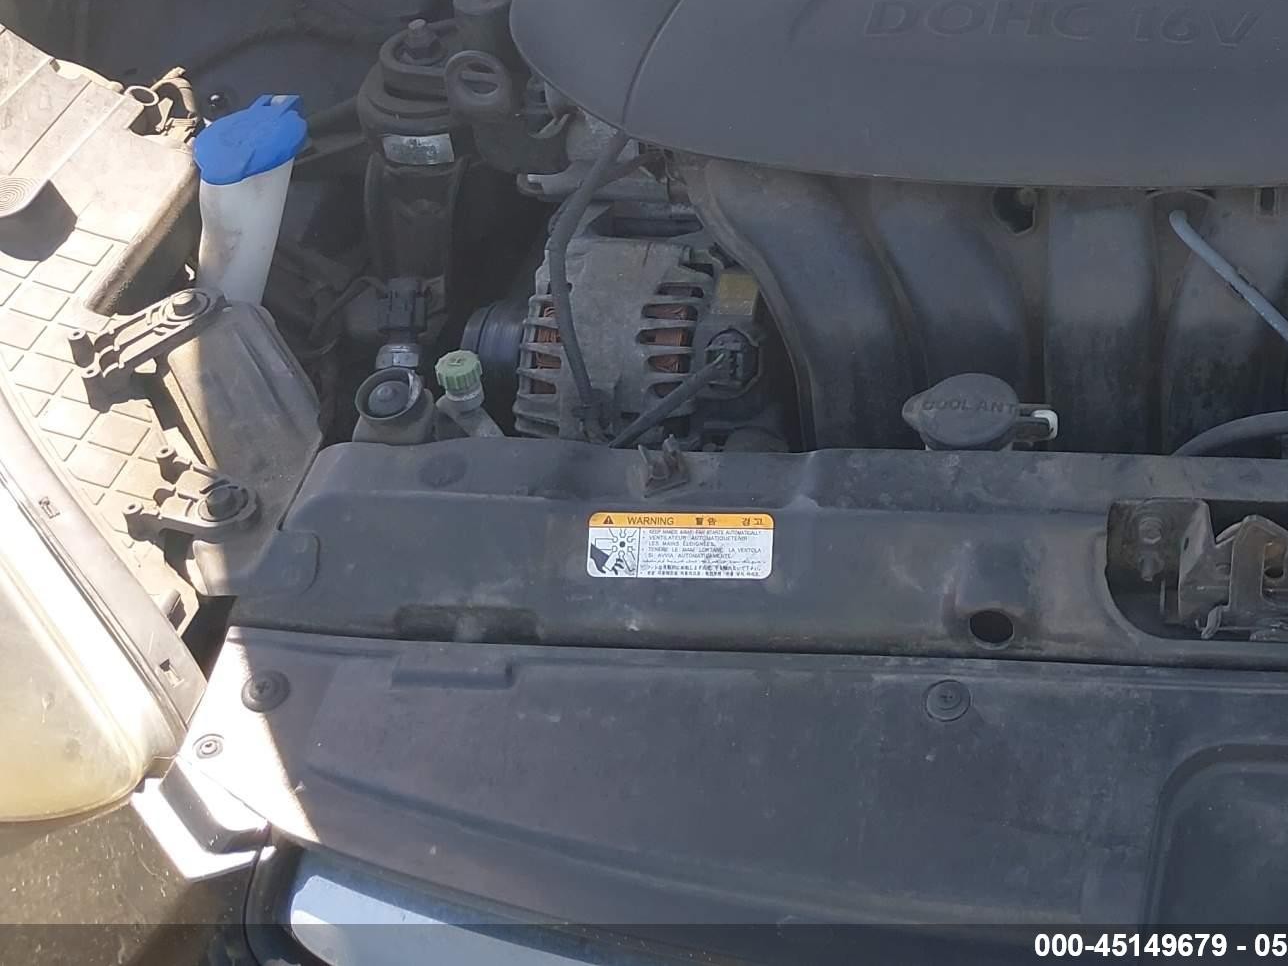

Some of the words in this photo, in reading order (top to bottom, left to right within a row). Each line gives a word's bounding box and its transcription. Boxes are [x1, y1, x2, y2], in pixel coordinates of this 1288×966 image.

[1129, 2, 1262, 49] 16V
[922, 399, 1017, 414] COOLANT
[627, 516, 674, 525] WARNING
